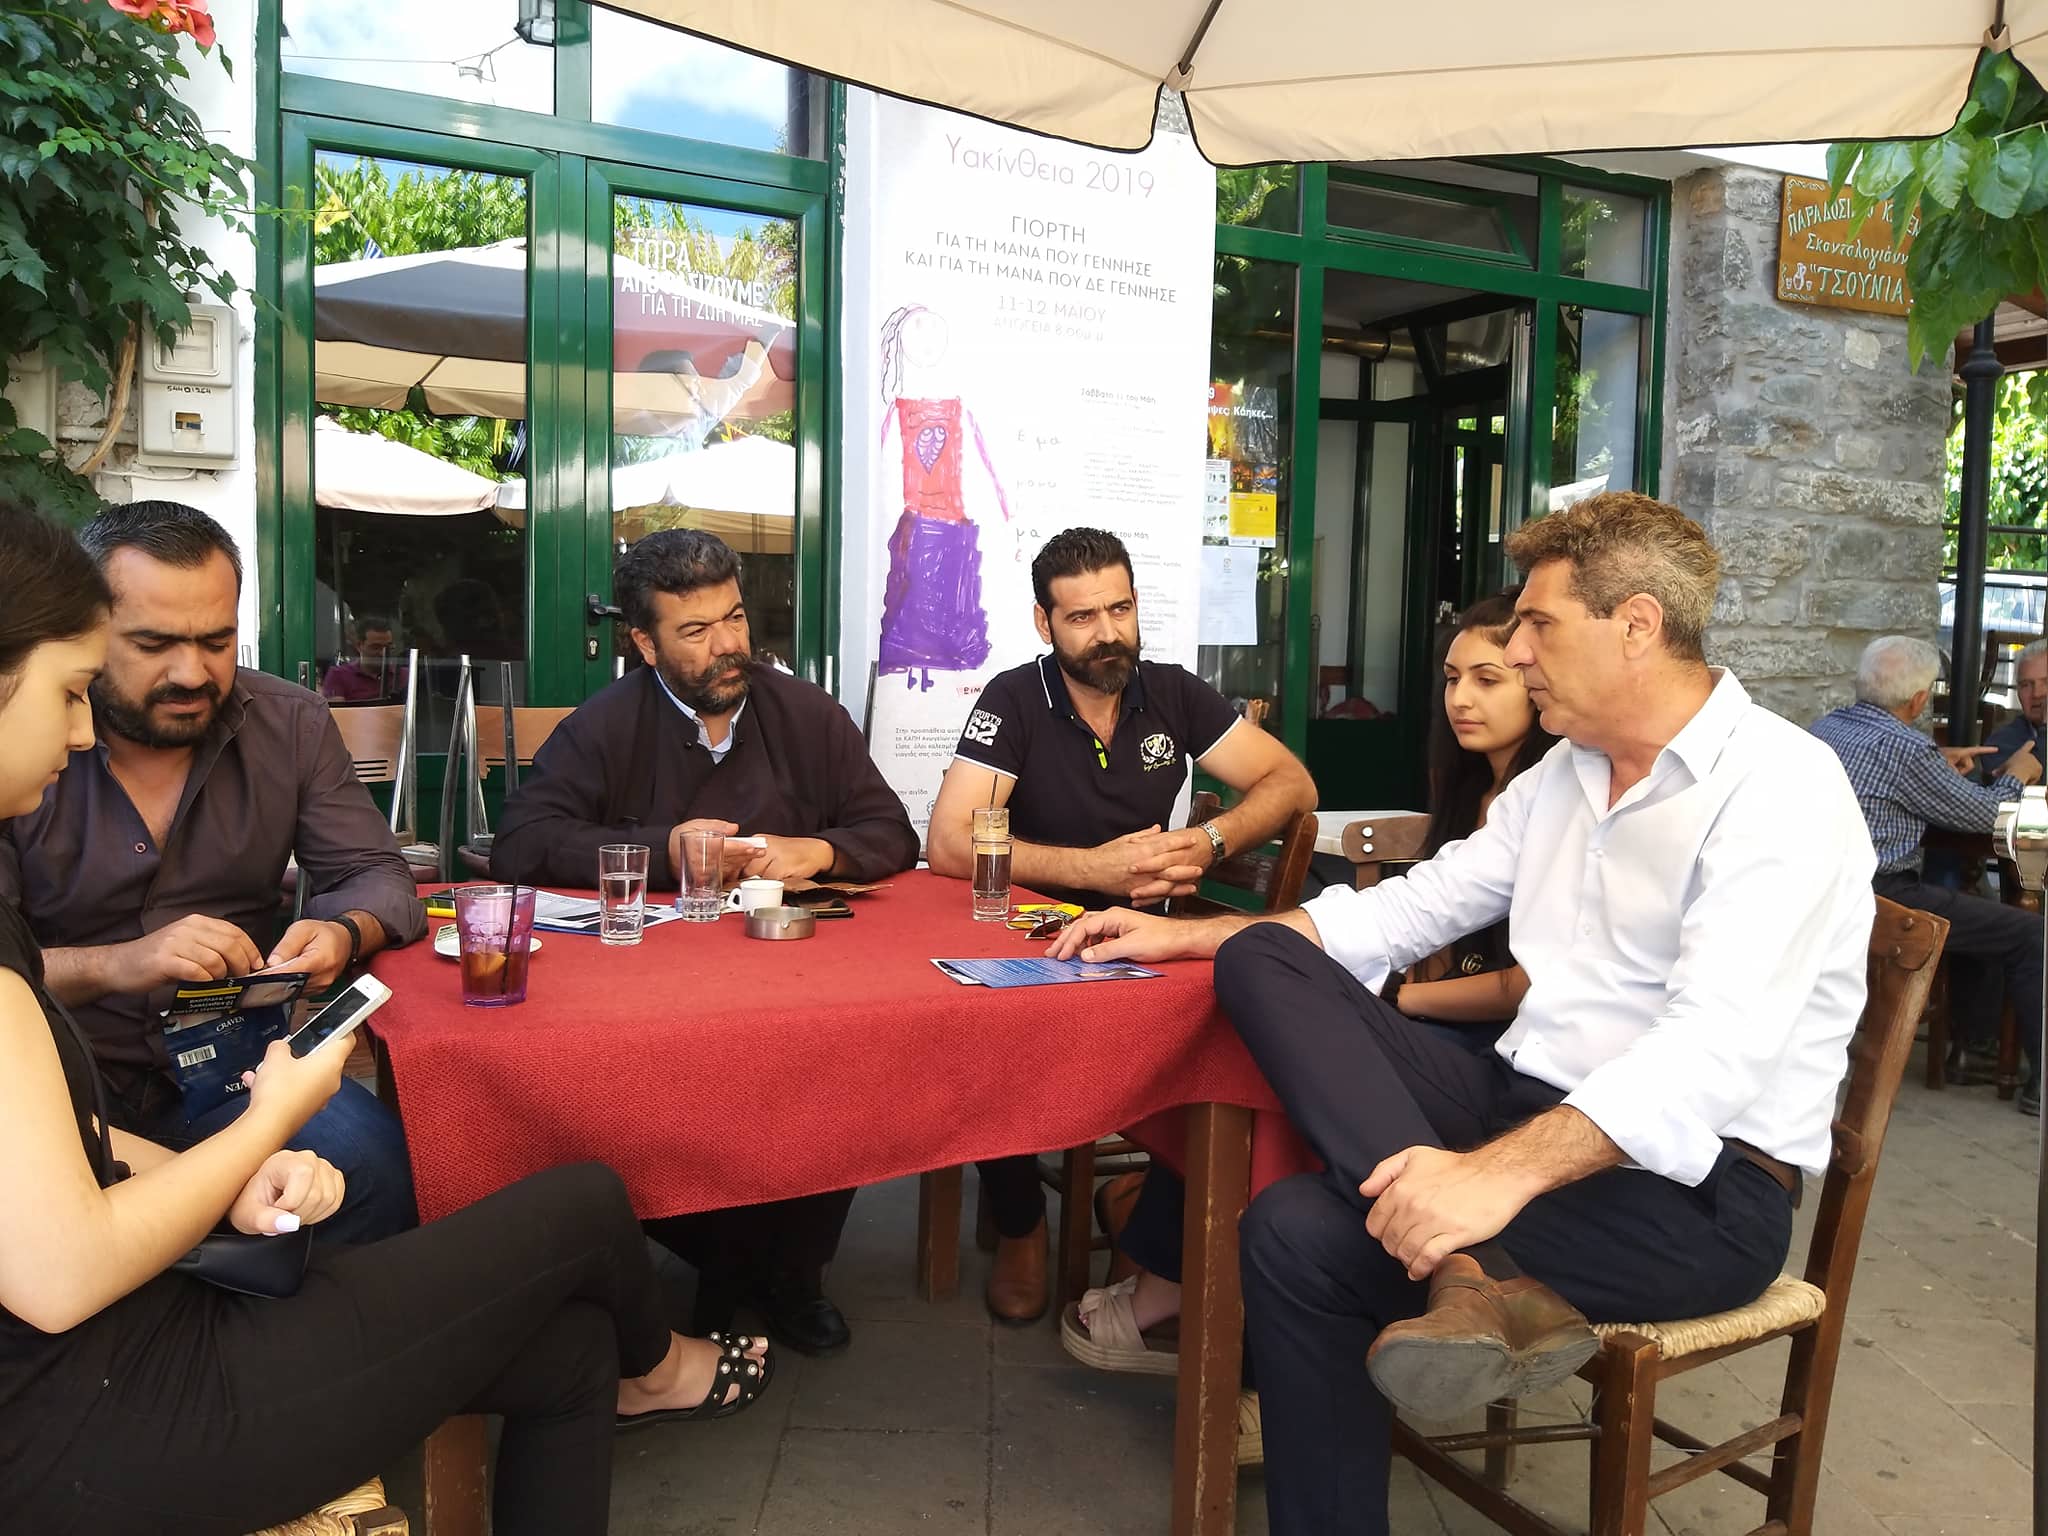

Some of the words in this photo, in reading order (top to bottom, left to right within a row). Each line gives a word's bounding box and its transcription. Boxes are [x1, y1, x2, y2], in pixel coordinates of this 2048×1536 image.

[945, 134, 1074, 186] Υακίνθεια
[1086, 161, 1155, 199] 2019
[1011, 216, 1086, 244] ΓΙΟΡΤΗ
[631, 238, 692, 273] ΤΩΡΑ
[936, 231, 962, 250] ΓΙΑ
[965, 236, 987, 252] ΤΗ
[994, 240, 1040, 260] ΜΑΝΑ
[1046, 248, 1080, 266] ΠΟΥ
[1084, 255, 1153, 278] ΓΕΝΝΗΣΕ
[1806, 233, 1910, 271] Σκανταλογιάνν
[905, 250, 933, 268] ΚΑΙ
[939, 255, 964, 272] ΓΙΑ
[967, 259, 989, 275] ΤΗ
[996, 264, 1044, 284] ΜΑΝΑ
[1049, 271, 1081, 290] ΠΟΥ
[1085, 277, 1106, 293] ΔΕ
[1110, 280, 1178, 304] ΓΕΝΝΗΣΕ
[641, 294, 667, 316] ΓΙΑ
[672, 295, 691, 318] ΤΗ
[997, 295, 1048, 316] 11-12
[1054, 302, 1107, 323] ΜΑΙΟΥ
[963, 717, 998, 747] 62
[216, 1016, 246, 1032] CRAVEN
